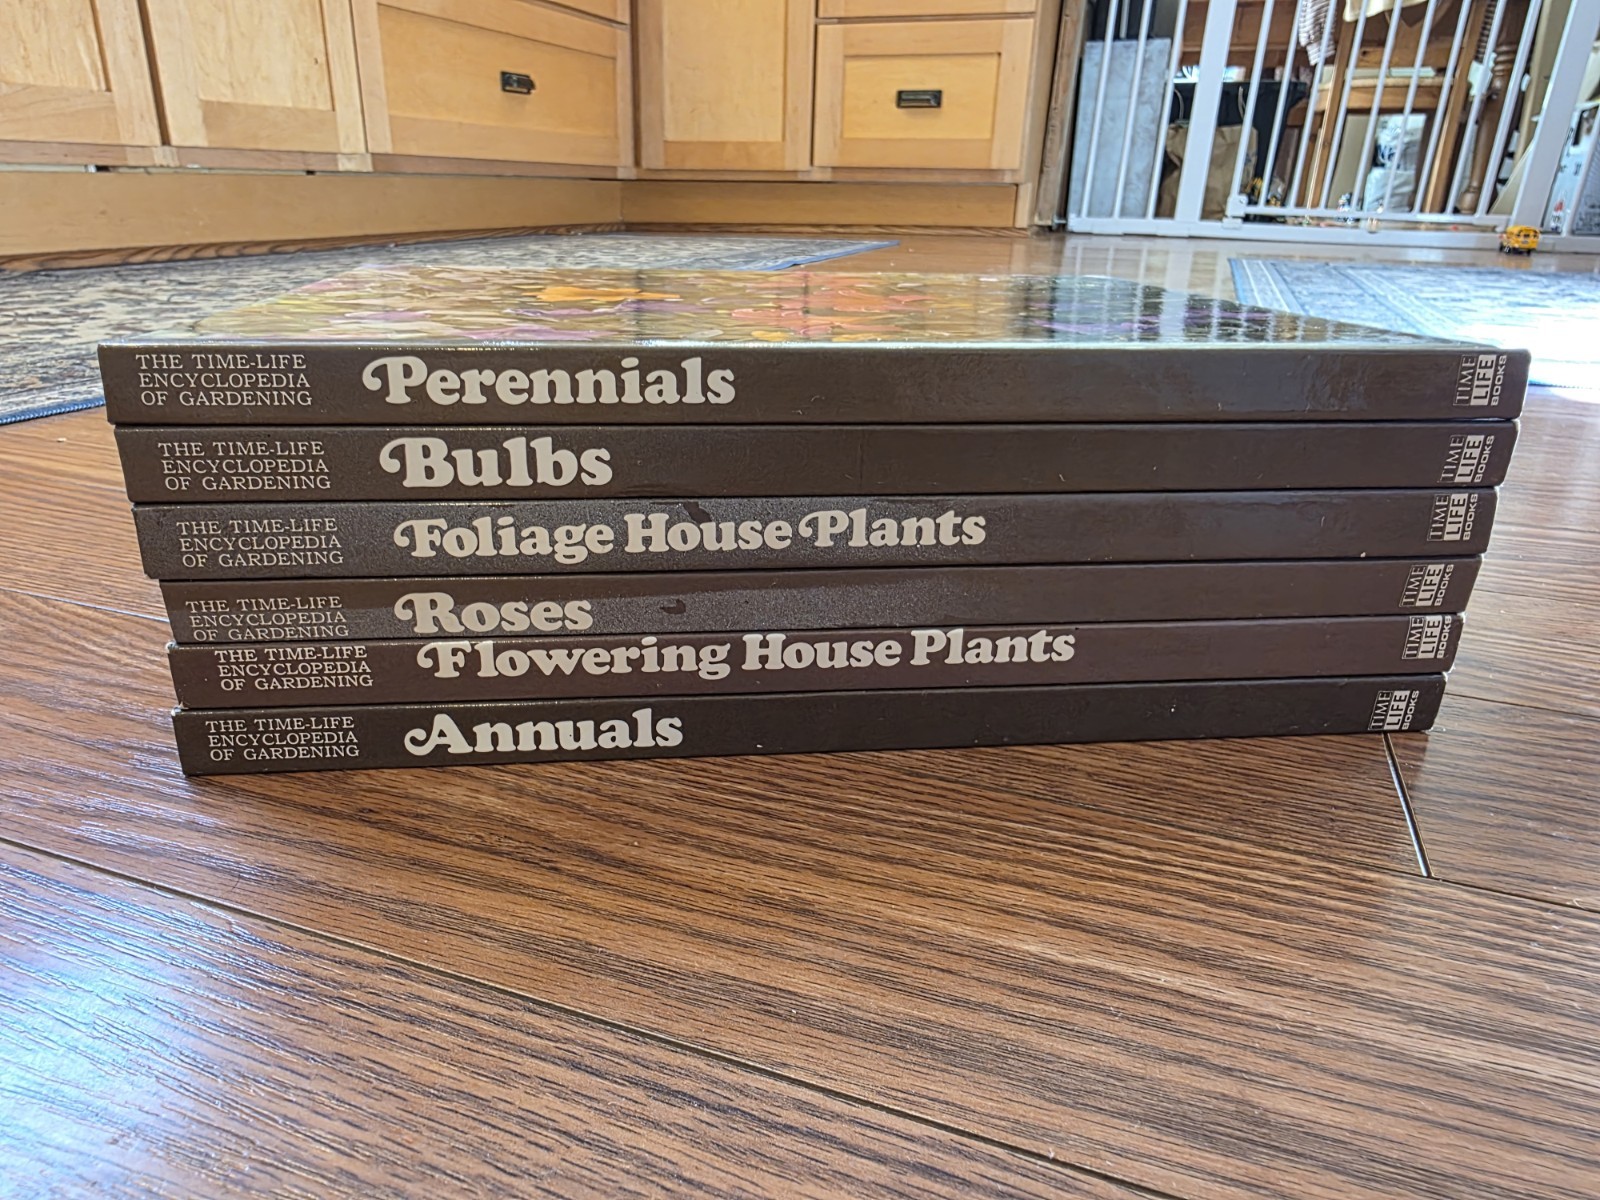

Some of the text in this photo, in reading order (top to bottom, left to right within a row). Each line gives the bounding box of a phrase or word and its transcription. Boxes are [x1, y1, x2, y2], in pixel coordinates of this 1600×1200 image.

[136, 354, 306, 369] THE TIME-LIFE
[139, 373, 310, 388] ENCYCLOPEDIA
[362, 356, 736, 405] Perennials
[1456, 357, 1477, 403] TIME
[1473, 359, 1494, 401] LIFE
[1491, 355, 1507, 406] BOOKS
[141, 391, 312, 406] OF GARDENING
[158, 442, 324, 457] THE TIME-LIFE
[163, 459, 329, 474] ENCYCLOPEDIA
[379, 436, 613, 487] Bulbs
[1440, 437, 1465, 481] TIME
[1457, 439, 1482, 477] LIFE
[1475, 436, 1494, 482] BOOKS
[165, 476, 331, 490] OF GARDENING
[177, 518, 337, 535] THE TIME-LIFE
[1429, 496, 1448, 538] TIME
[1446, 497, 1467, 536] LIFE
[1463, 494, 1478, 540] BOOKS
[180, 535, 341, 551] ENCYCLOPEDIA
[394, 509, 986, 564] Foliage House Plants
[182, 551, 343, 567] OF GARDENING
[1402, 567, 1426, 606] TIME
[1419, 567, 1441, 602] LIFE
[1435, 564, 1454, 606] BOOKS
[186, 596, 342, 613] THE TIME-LIFE
[190, 612, 346, 628] ENCYCLOPEDIA
[394, 591, 593, 634] Roses
[193, 626, 349, 641] OF GARDENING
[1404, 617, 1424, 657] TIME
[1421, 619, 1440, 655] LIFE
[1437, 616, 1452, 658] BOOKS
[215, 646, 368, 662] THE TIME-LIFE
[218, 662, 371, 677] ENCYCLOPEDIA
[416, 628, 1075, 680] Flowering House Plants
[220, 675, 373, 691] OF GARDENING
[206, 717, 355, 732] THE TIME-LIFE
[1371, 693, 1391, 728] TIME
[1387, 695, 1407, 725] LIFE
[1402, 691, 1419, 730] BOOKS
[209, 732, 358, 746] ENCYCLOPEDIA
[404, 708, 683, 756] Annuals
[210, 745, 359, 761] OF GARDENING
